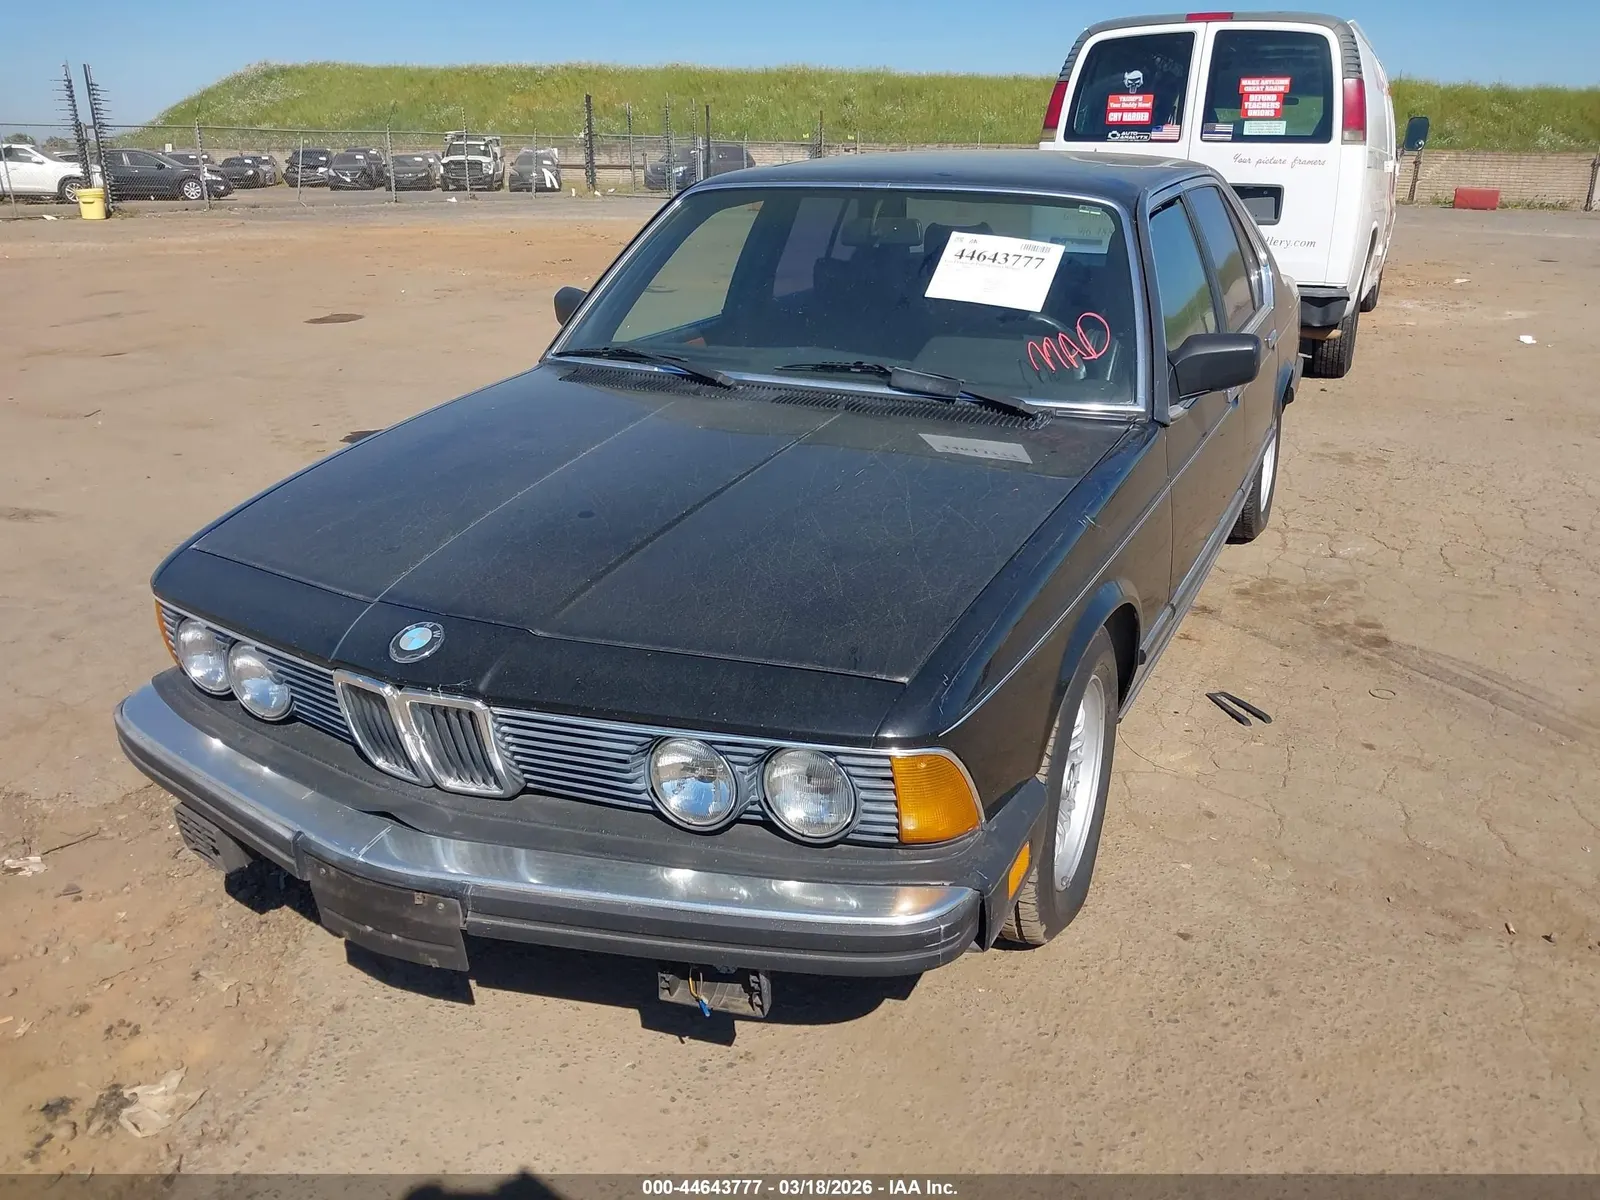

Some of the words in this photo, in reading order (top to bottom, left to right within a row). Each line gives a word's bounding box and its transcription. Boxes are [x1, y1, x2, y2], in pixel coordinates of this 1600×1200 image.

[1249, 94, 1277, 102] DEFUND
[1244, 101, 1281, 110] TEACHERS
[1108, 112, 1123, 122] CRY
[1122, 112, 1149, 122] HARDER
[1247, 109, 1275, 117] UNIONS
[1233, 153, 1252, 164] Your
[1254, 156, 1287, 168] picture
[1290, 156, 1327, 169] framers
[954, 247, 1045, 270] 44643777
